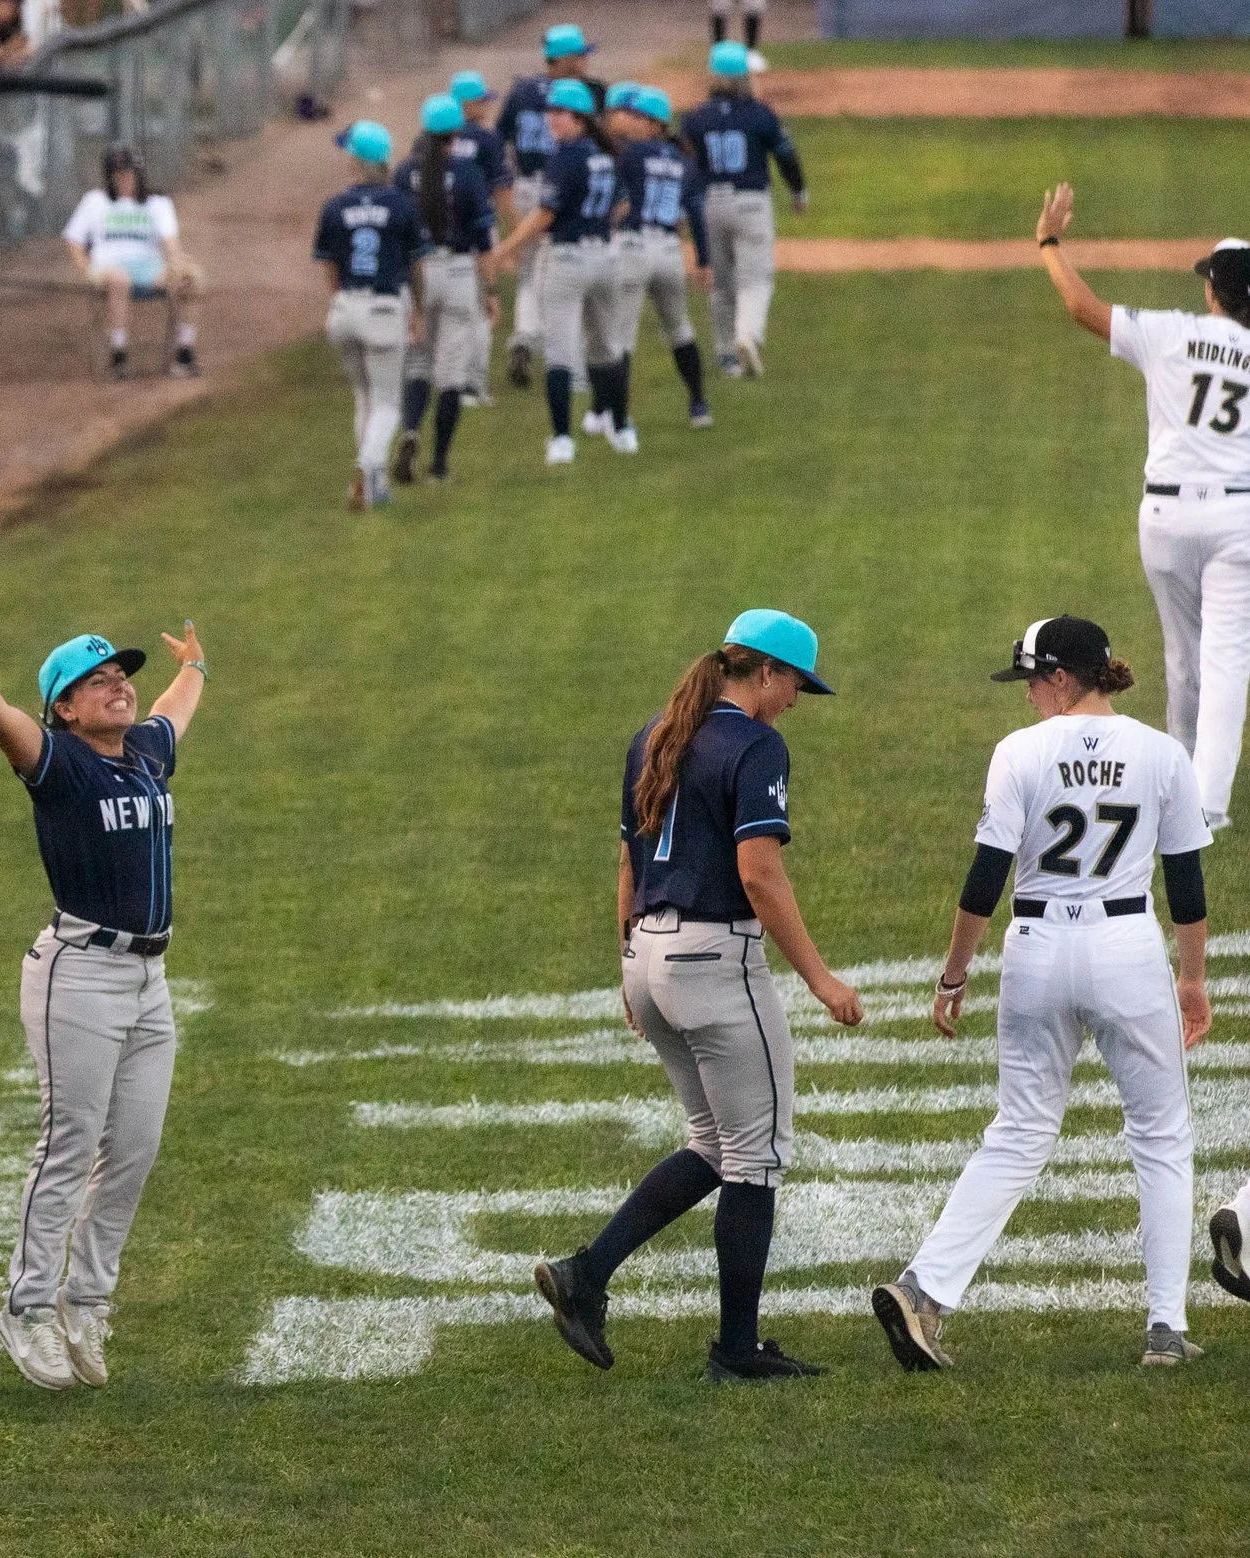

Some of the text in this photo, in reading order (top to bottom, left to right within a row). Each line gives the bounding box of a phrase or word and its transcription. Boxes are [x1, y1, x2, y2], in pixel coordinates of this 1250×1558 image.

[351, 226, 381, 277] 2
[1187, 372, 1250, 434] 13
[1083, 737, 1099, 751] W
[1058, 759, 1126, 789] ROCHE
[99, 795, 150, 832] NEW
[1037, 802, 1141, 880] 27
[1066, 904, 1082, 921] W
